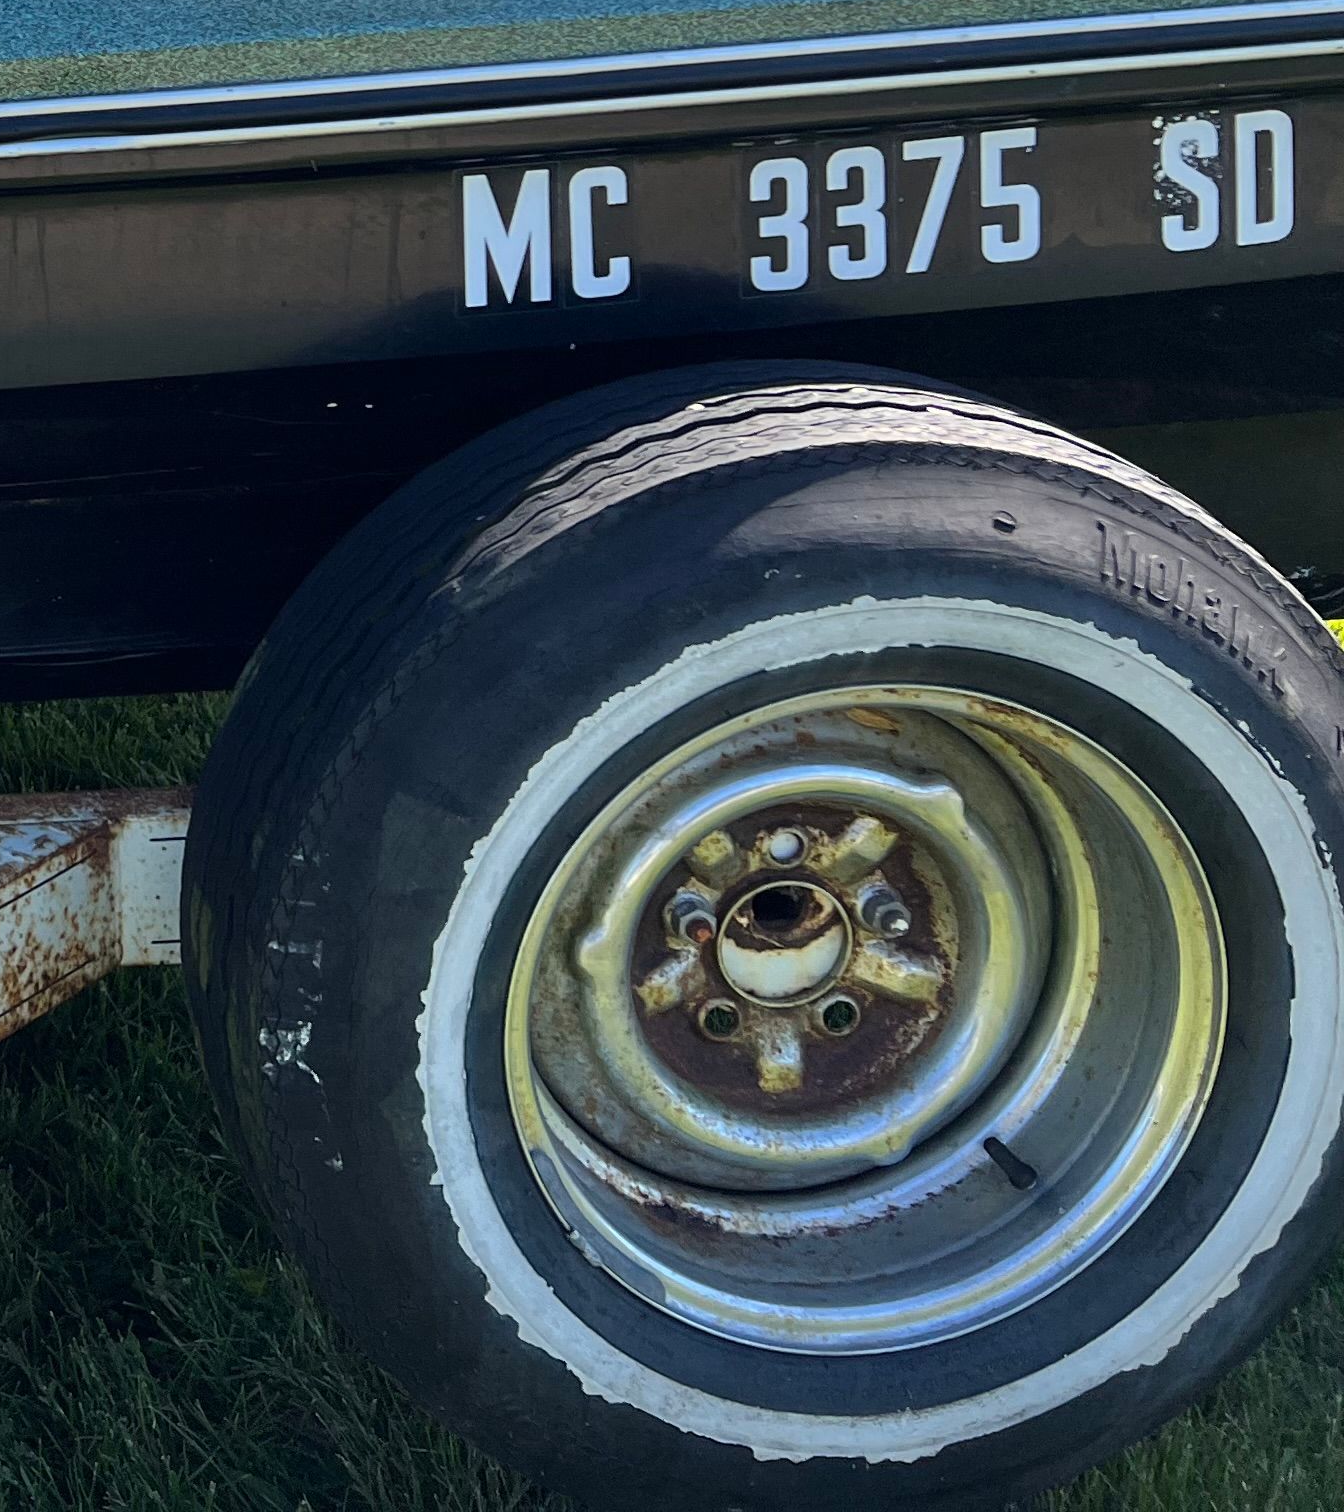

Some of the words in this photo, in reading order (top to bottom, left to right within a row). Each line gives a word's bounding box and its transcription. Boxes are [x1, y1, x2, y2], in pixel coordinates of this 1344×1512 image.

[462, 165, 631, 308] MC
[748, 126, 1042, 292] 3375
[1158, 109, 1295, 253] SD
